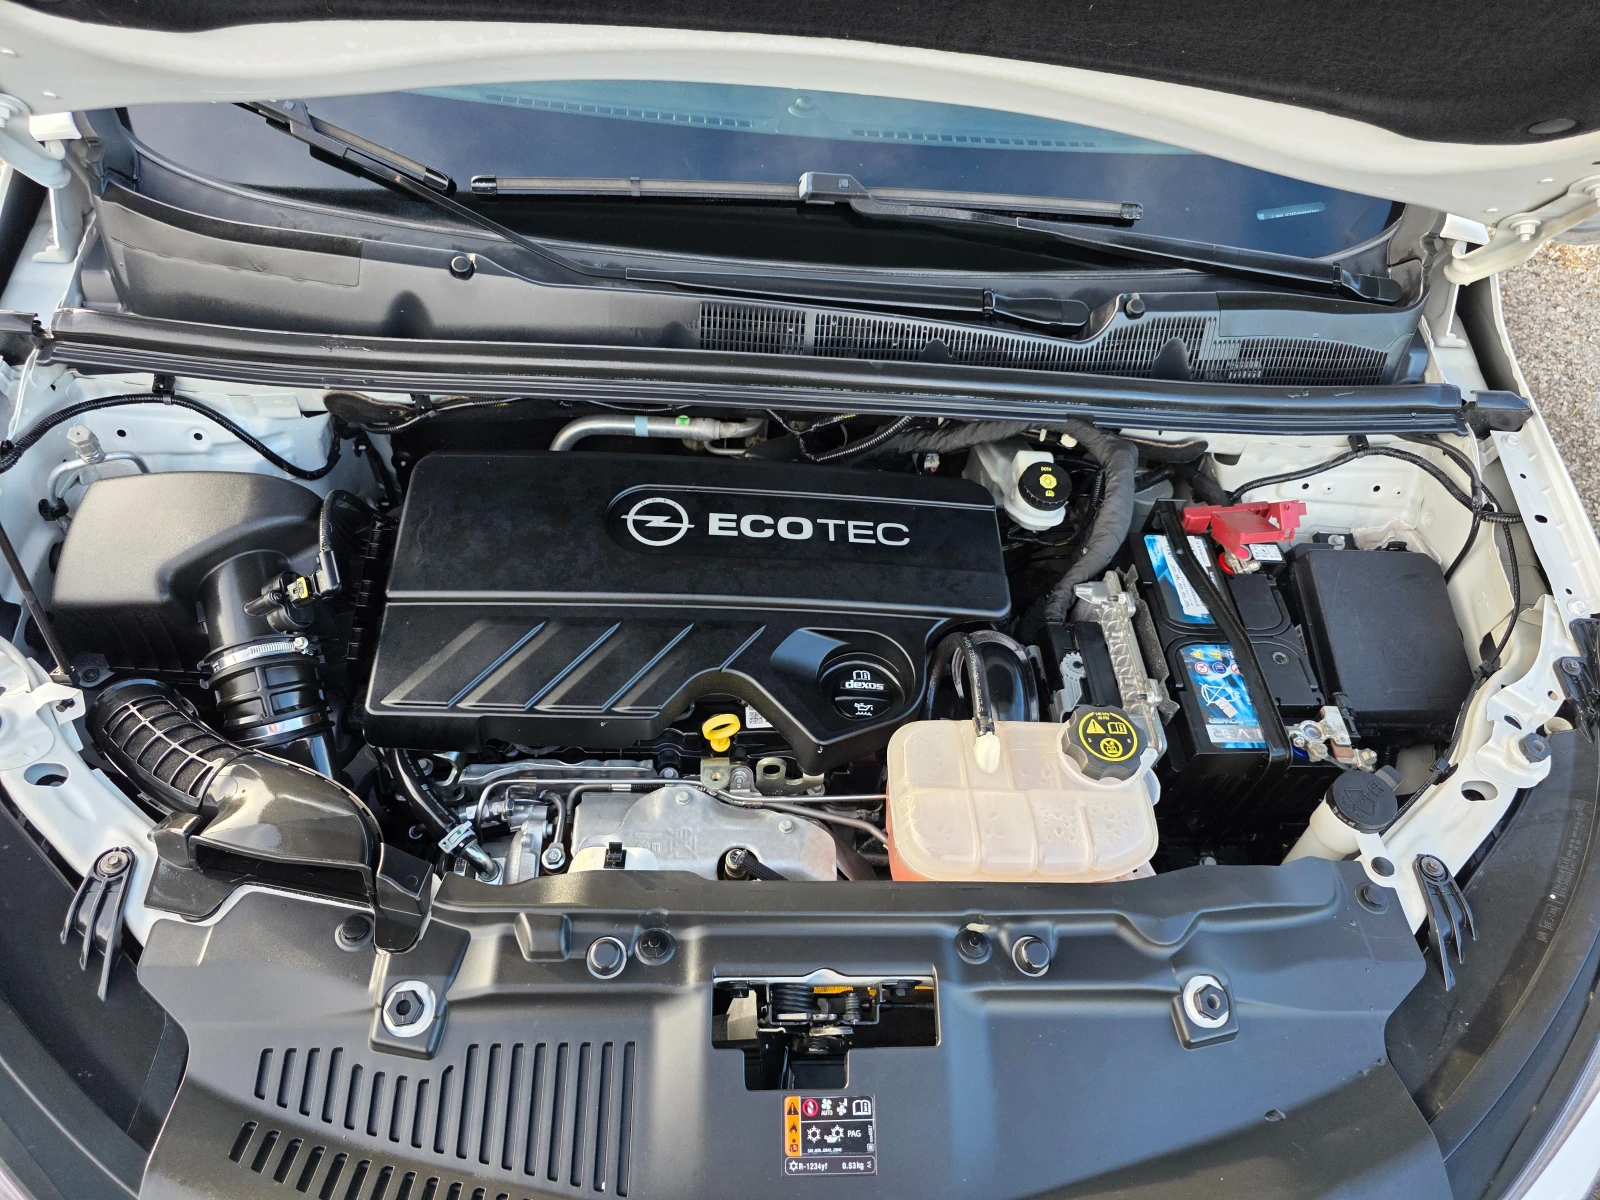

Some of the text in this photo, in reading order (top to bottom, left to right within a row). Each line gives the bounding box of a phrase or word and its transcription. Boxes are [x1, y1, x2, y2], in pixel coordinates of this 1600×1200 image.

[708, 512, 910, 546] ECOTEC
[845, 680, 885, 690] dexos
[1212, 728, 1264, 740] ILVER
[847, 1129, 862, 1138] PAG
[798, 1162, 828, 1171] R-1234yf
